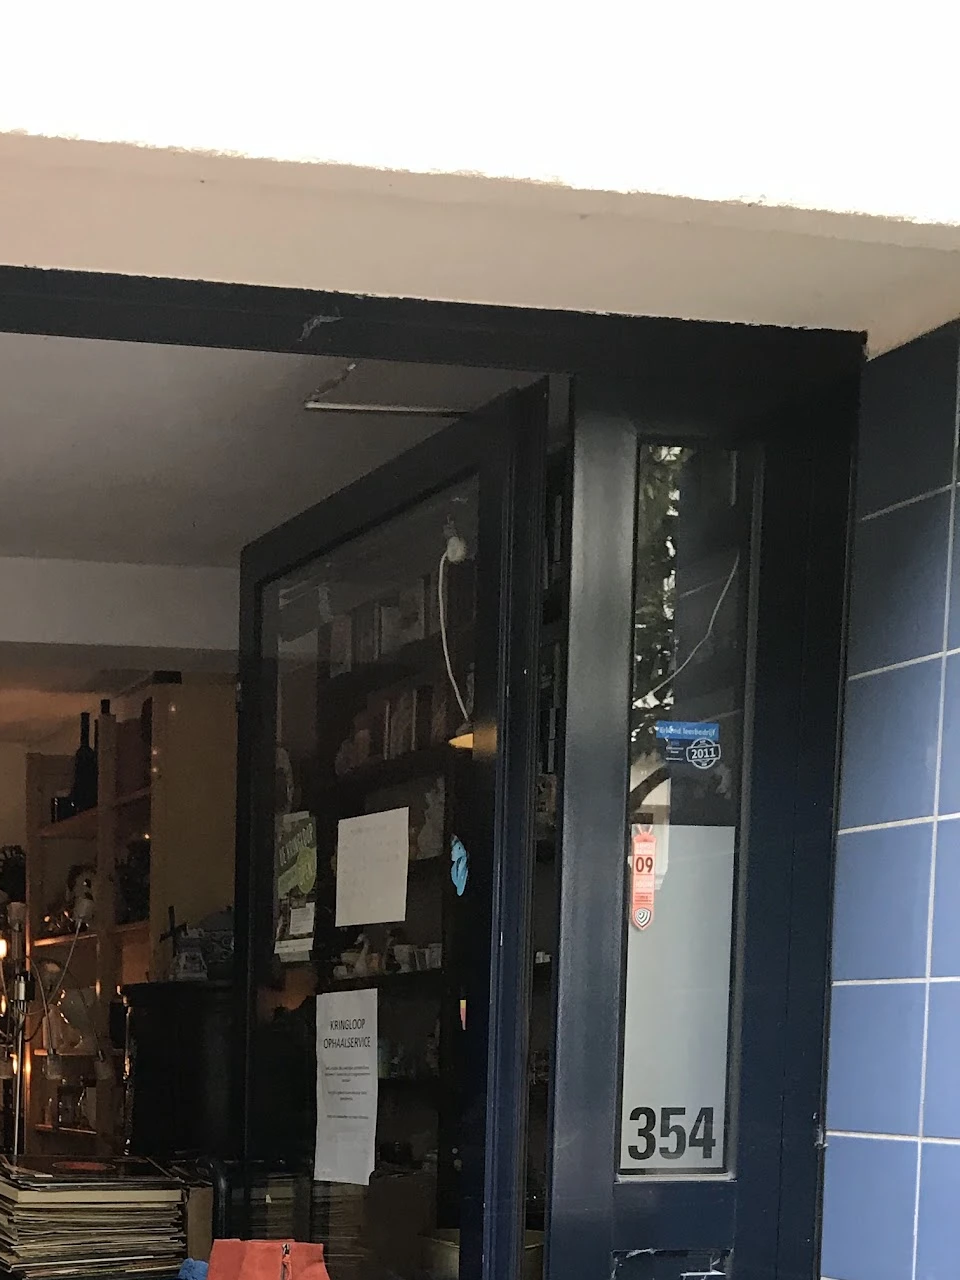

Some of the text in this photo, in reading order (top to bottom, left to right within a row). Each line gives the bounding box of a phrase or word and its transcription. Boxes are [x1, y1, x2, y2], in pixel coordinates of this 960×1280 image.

[691, 747, 716, 759] 2011
[635, 856, 654, 873] 09
[329, 1018, 366, 1031] KRINGLOOP
[323, 1036, 371, 1049] OPHAALSERVICE
[628, 1106, 717, 1160] 354
